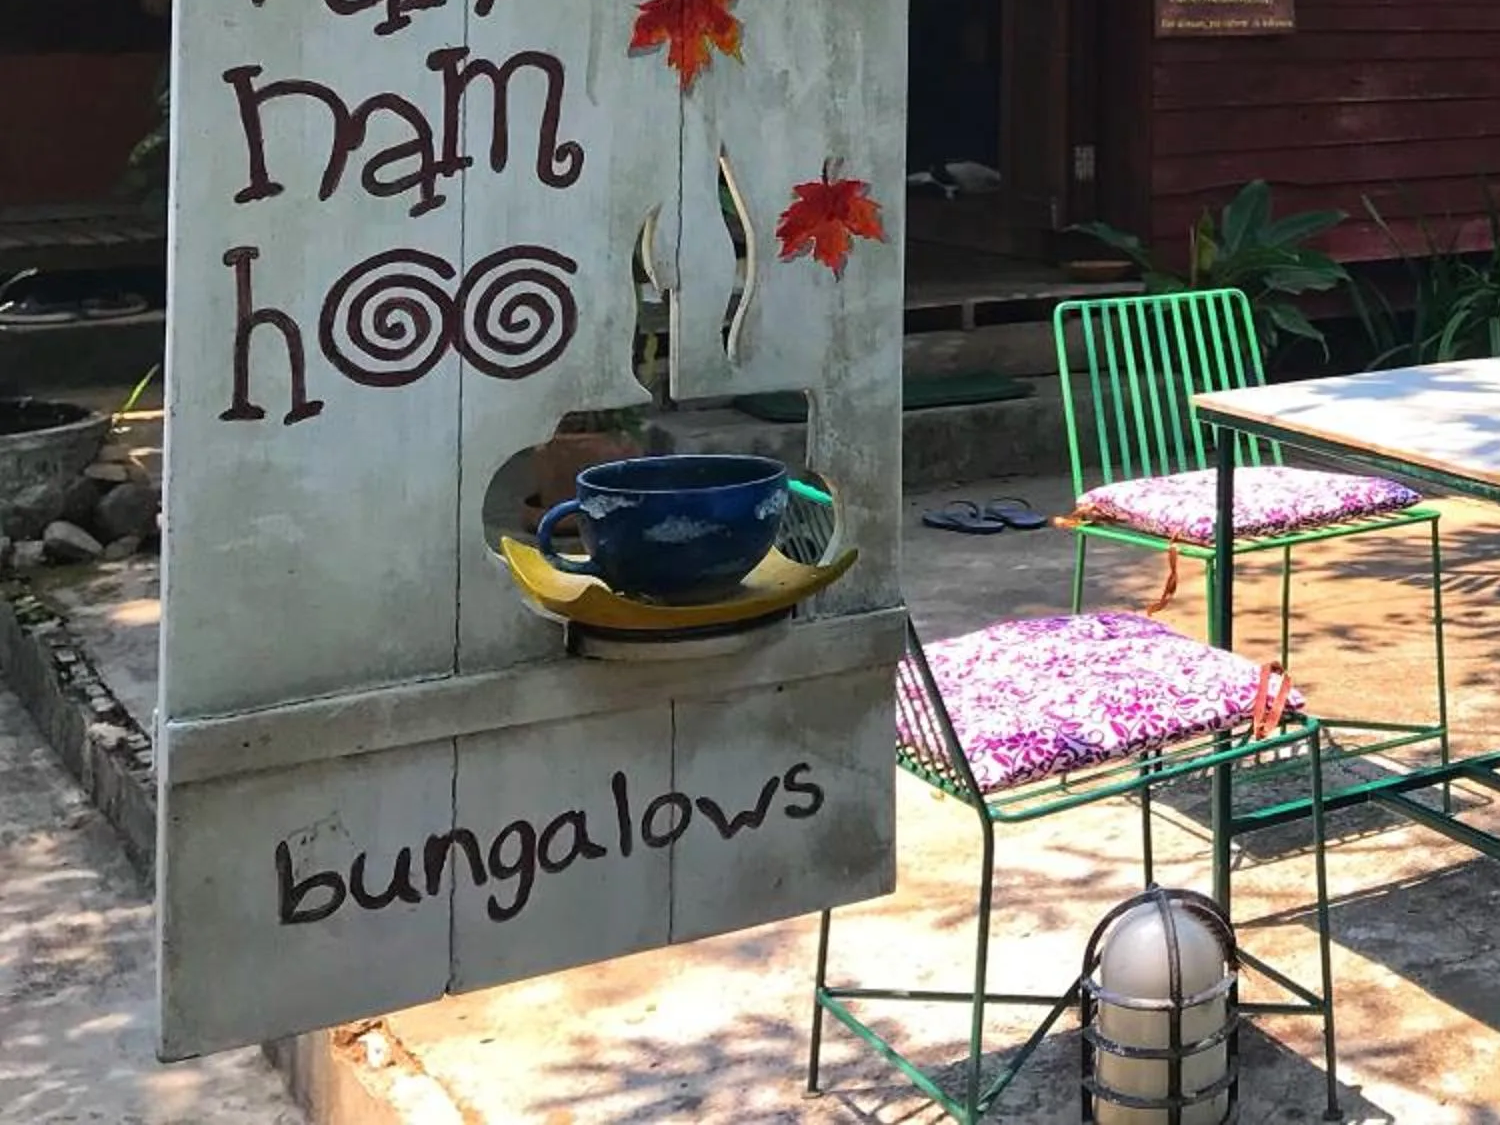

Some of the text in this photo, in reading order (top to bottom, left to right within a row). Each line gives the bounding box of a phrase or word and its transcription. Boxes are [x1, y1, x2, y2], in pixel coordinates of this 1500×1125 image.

[223, 46, 584, 217] nam
[219, 244, 578, 425] hoo
[276, 763, 825, 925] bungalows
